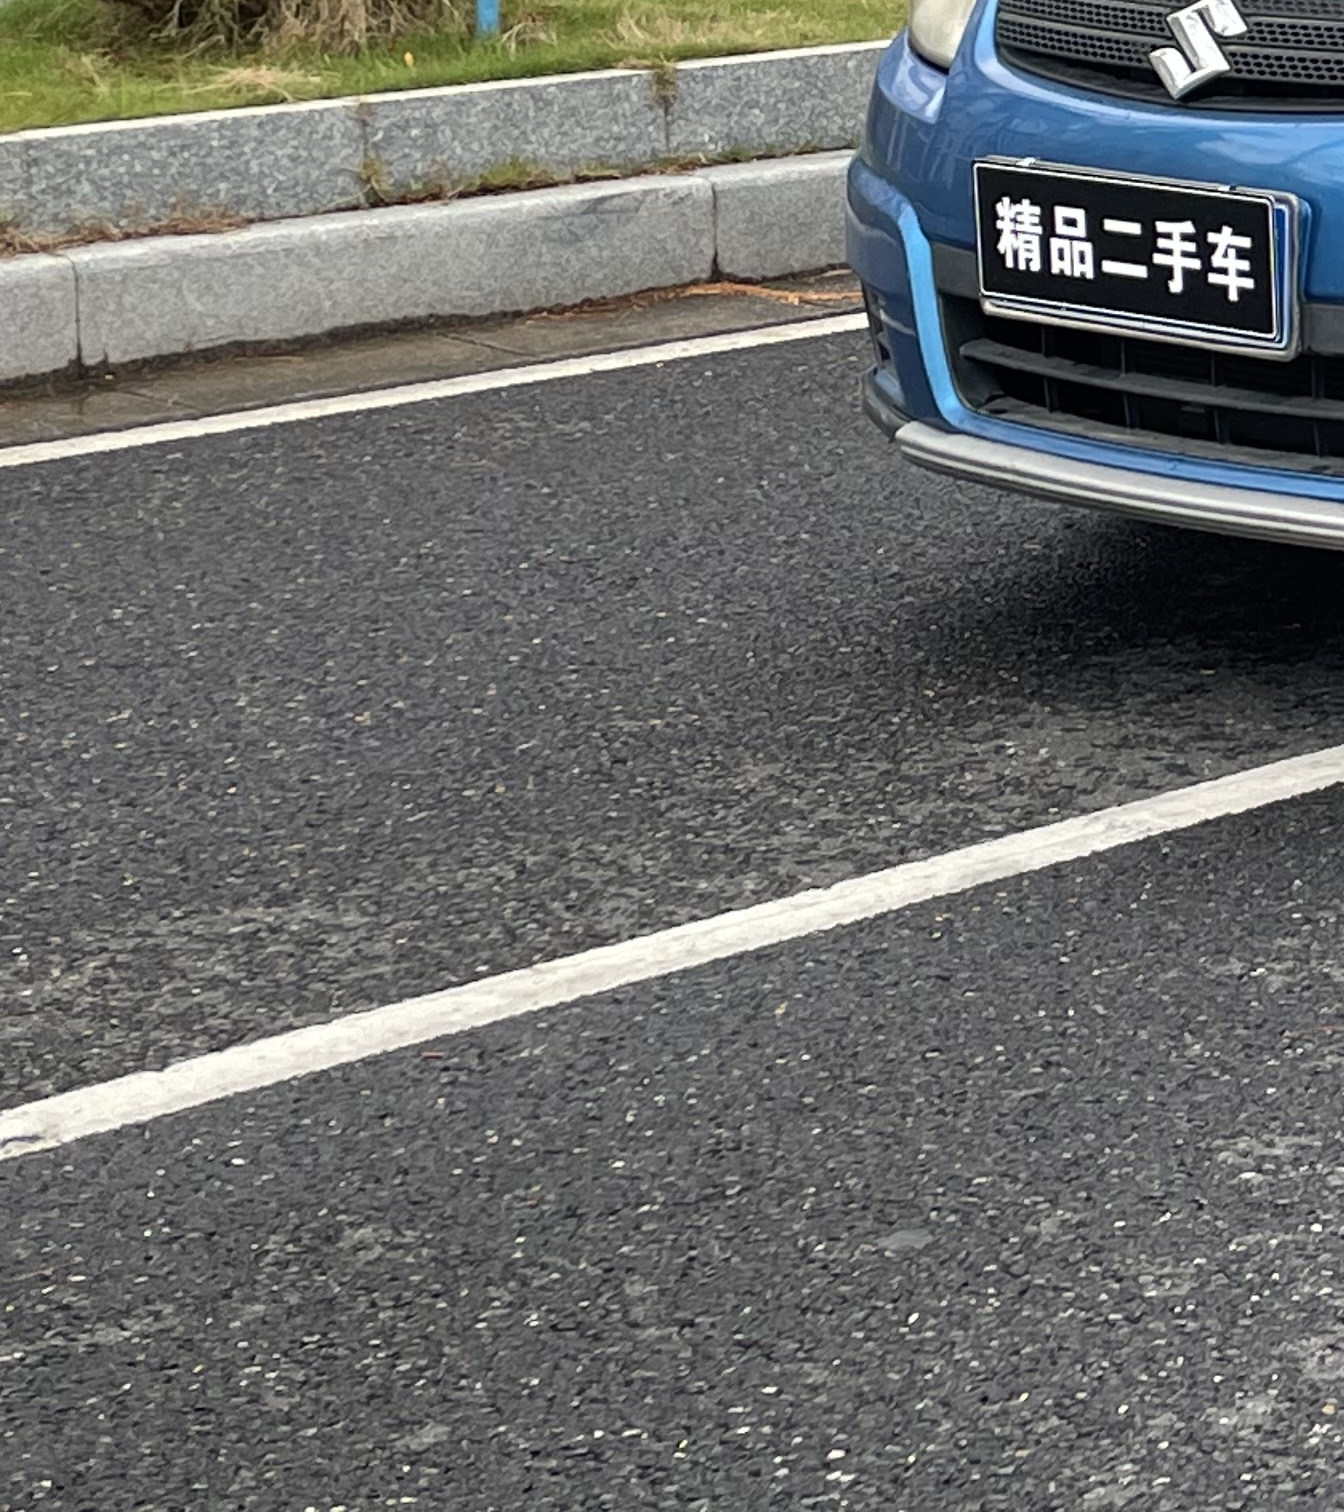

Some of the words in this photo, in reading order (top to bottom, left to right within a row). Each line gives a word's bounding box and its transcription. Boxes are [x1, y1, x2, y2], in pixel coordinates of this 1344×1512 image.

[995, 196, 1255, 302] 精品二手车
